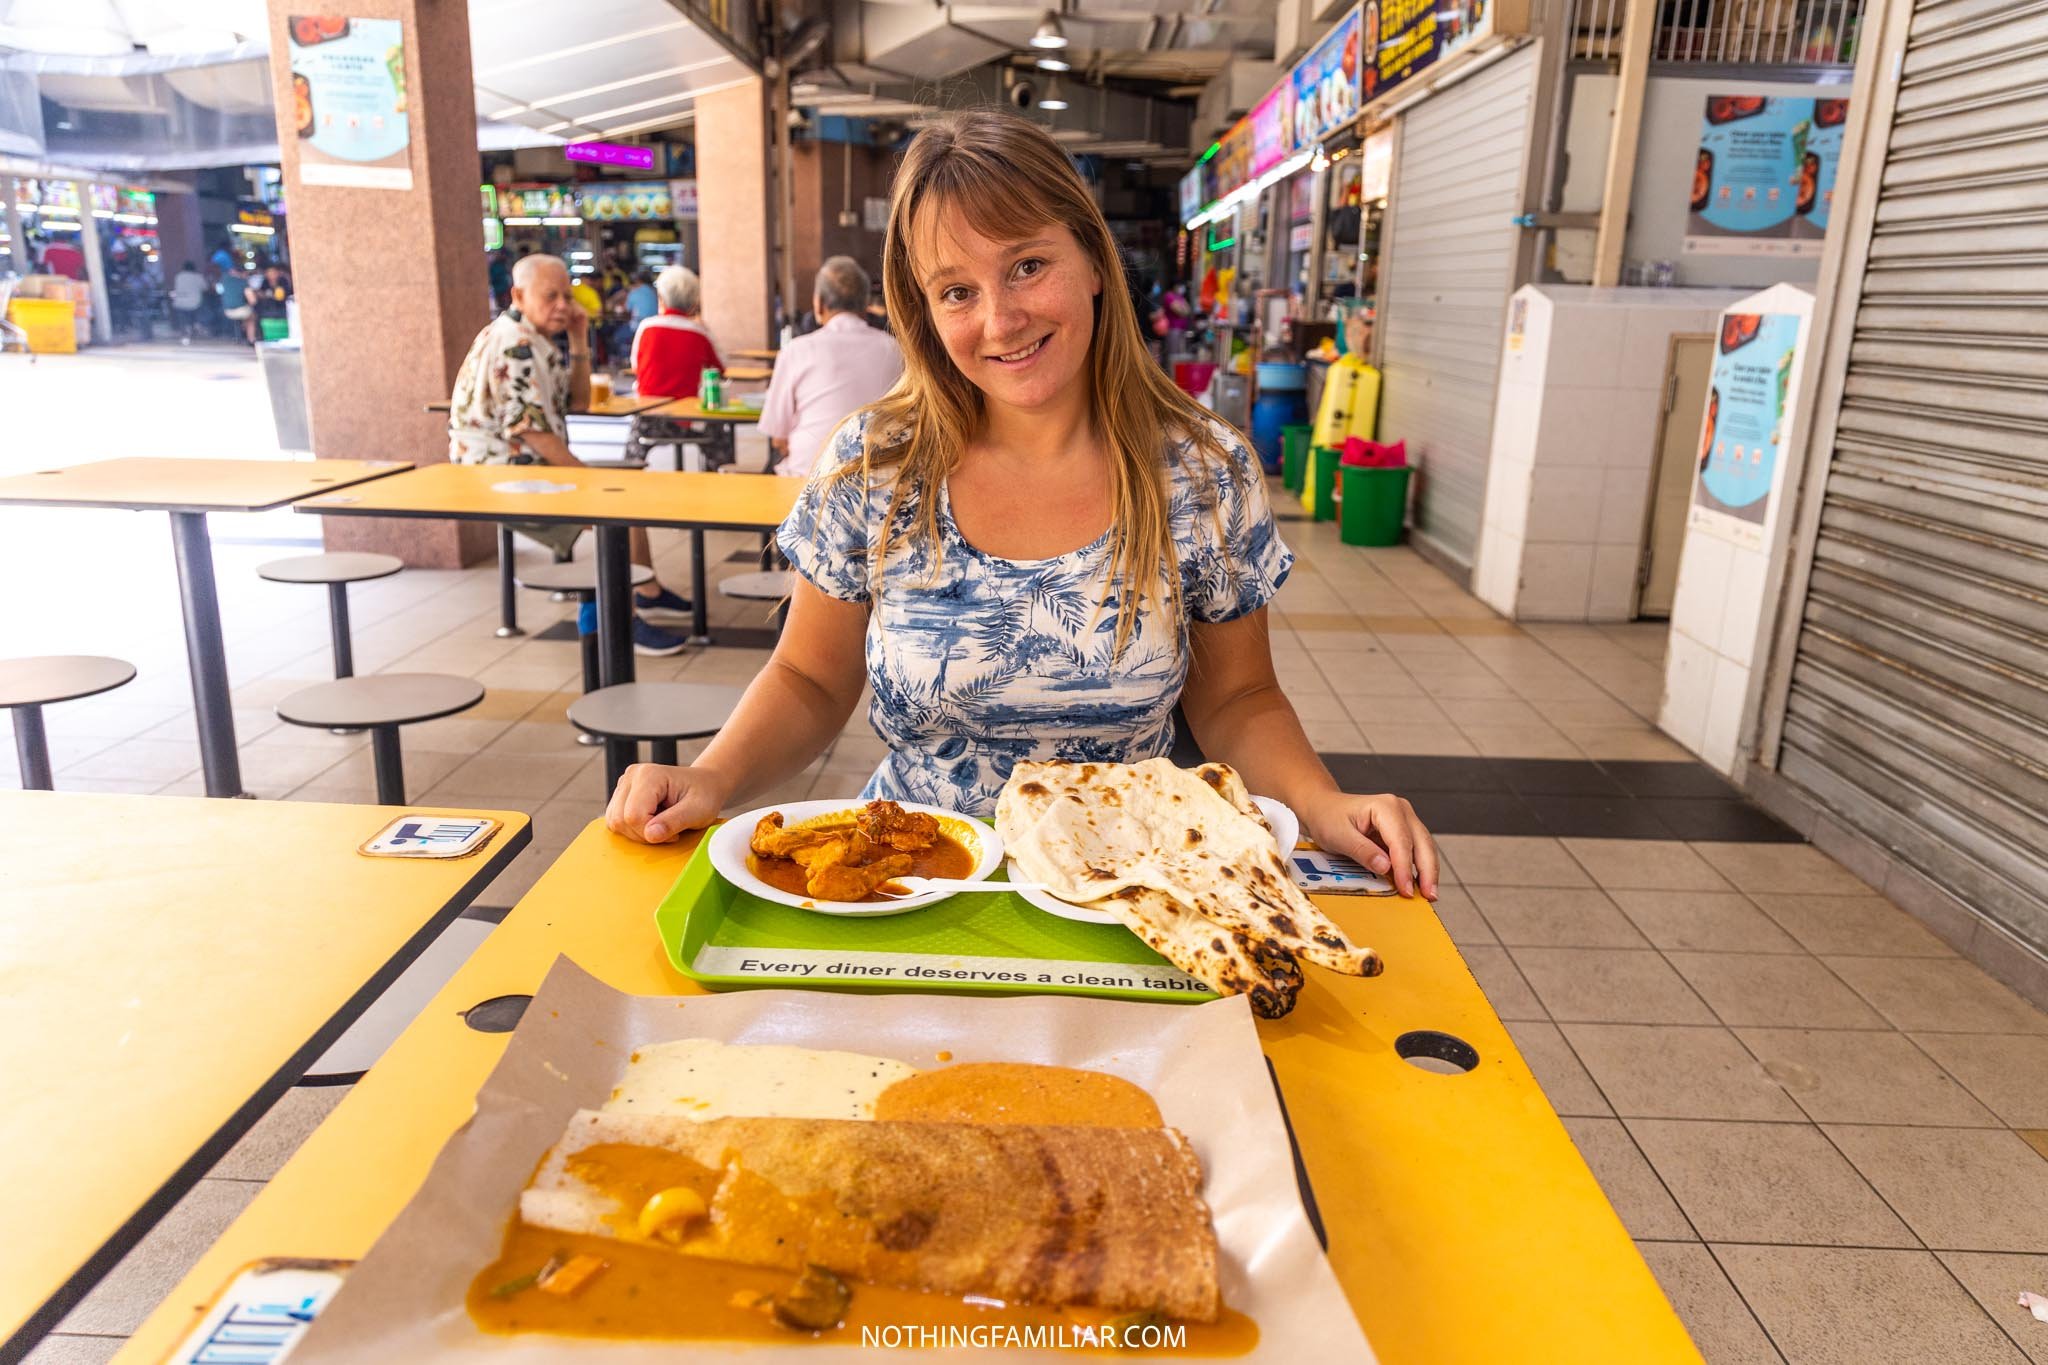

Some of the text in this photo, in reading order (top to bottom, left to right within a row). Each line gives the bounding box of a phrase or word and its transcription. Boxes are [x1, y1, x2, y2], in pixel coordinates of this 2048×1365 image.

[740, 960, 1208, 991] Every diner deserves a clean table
